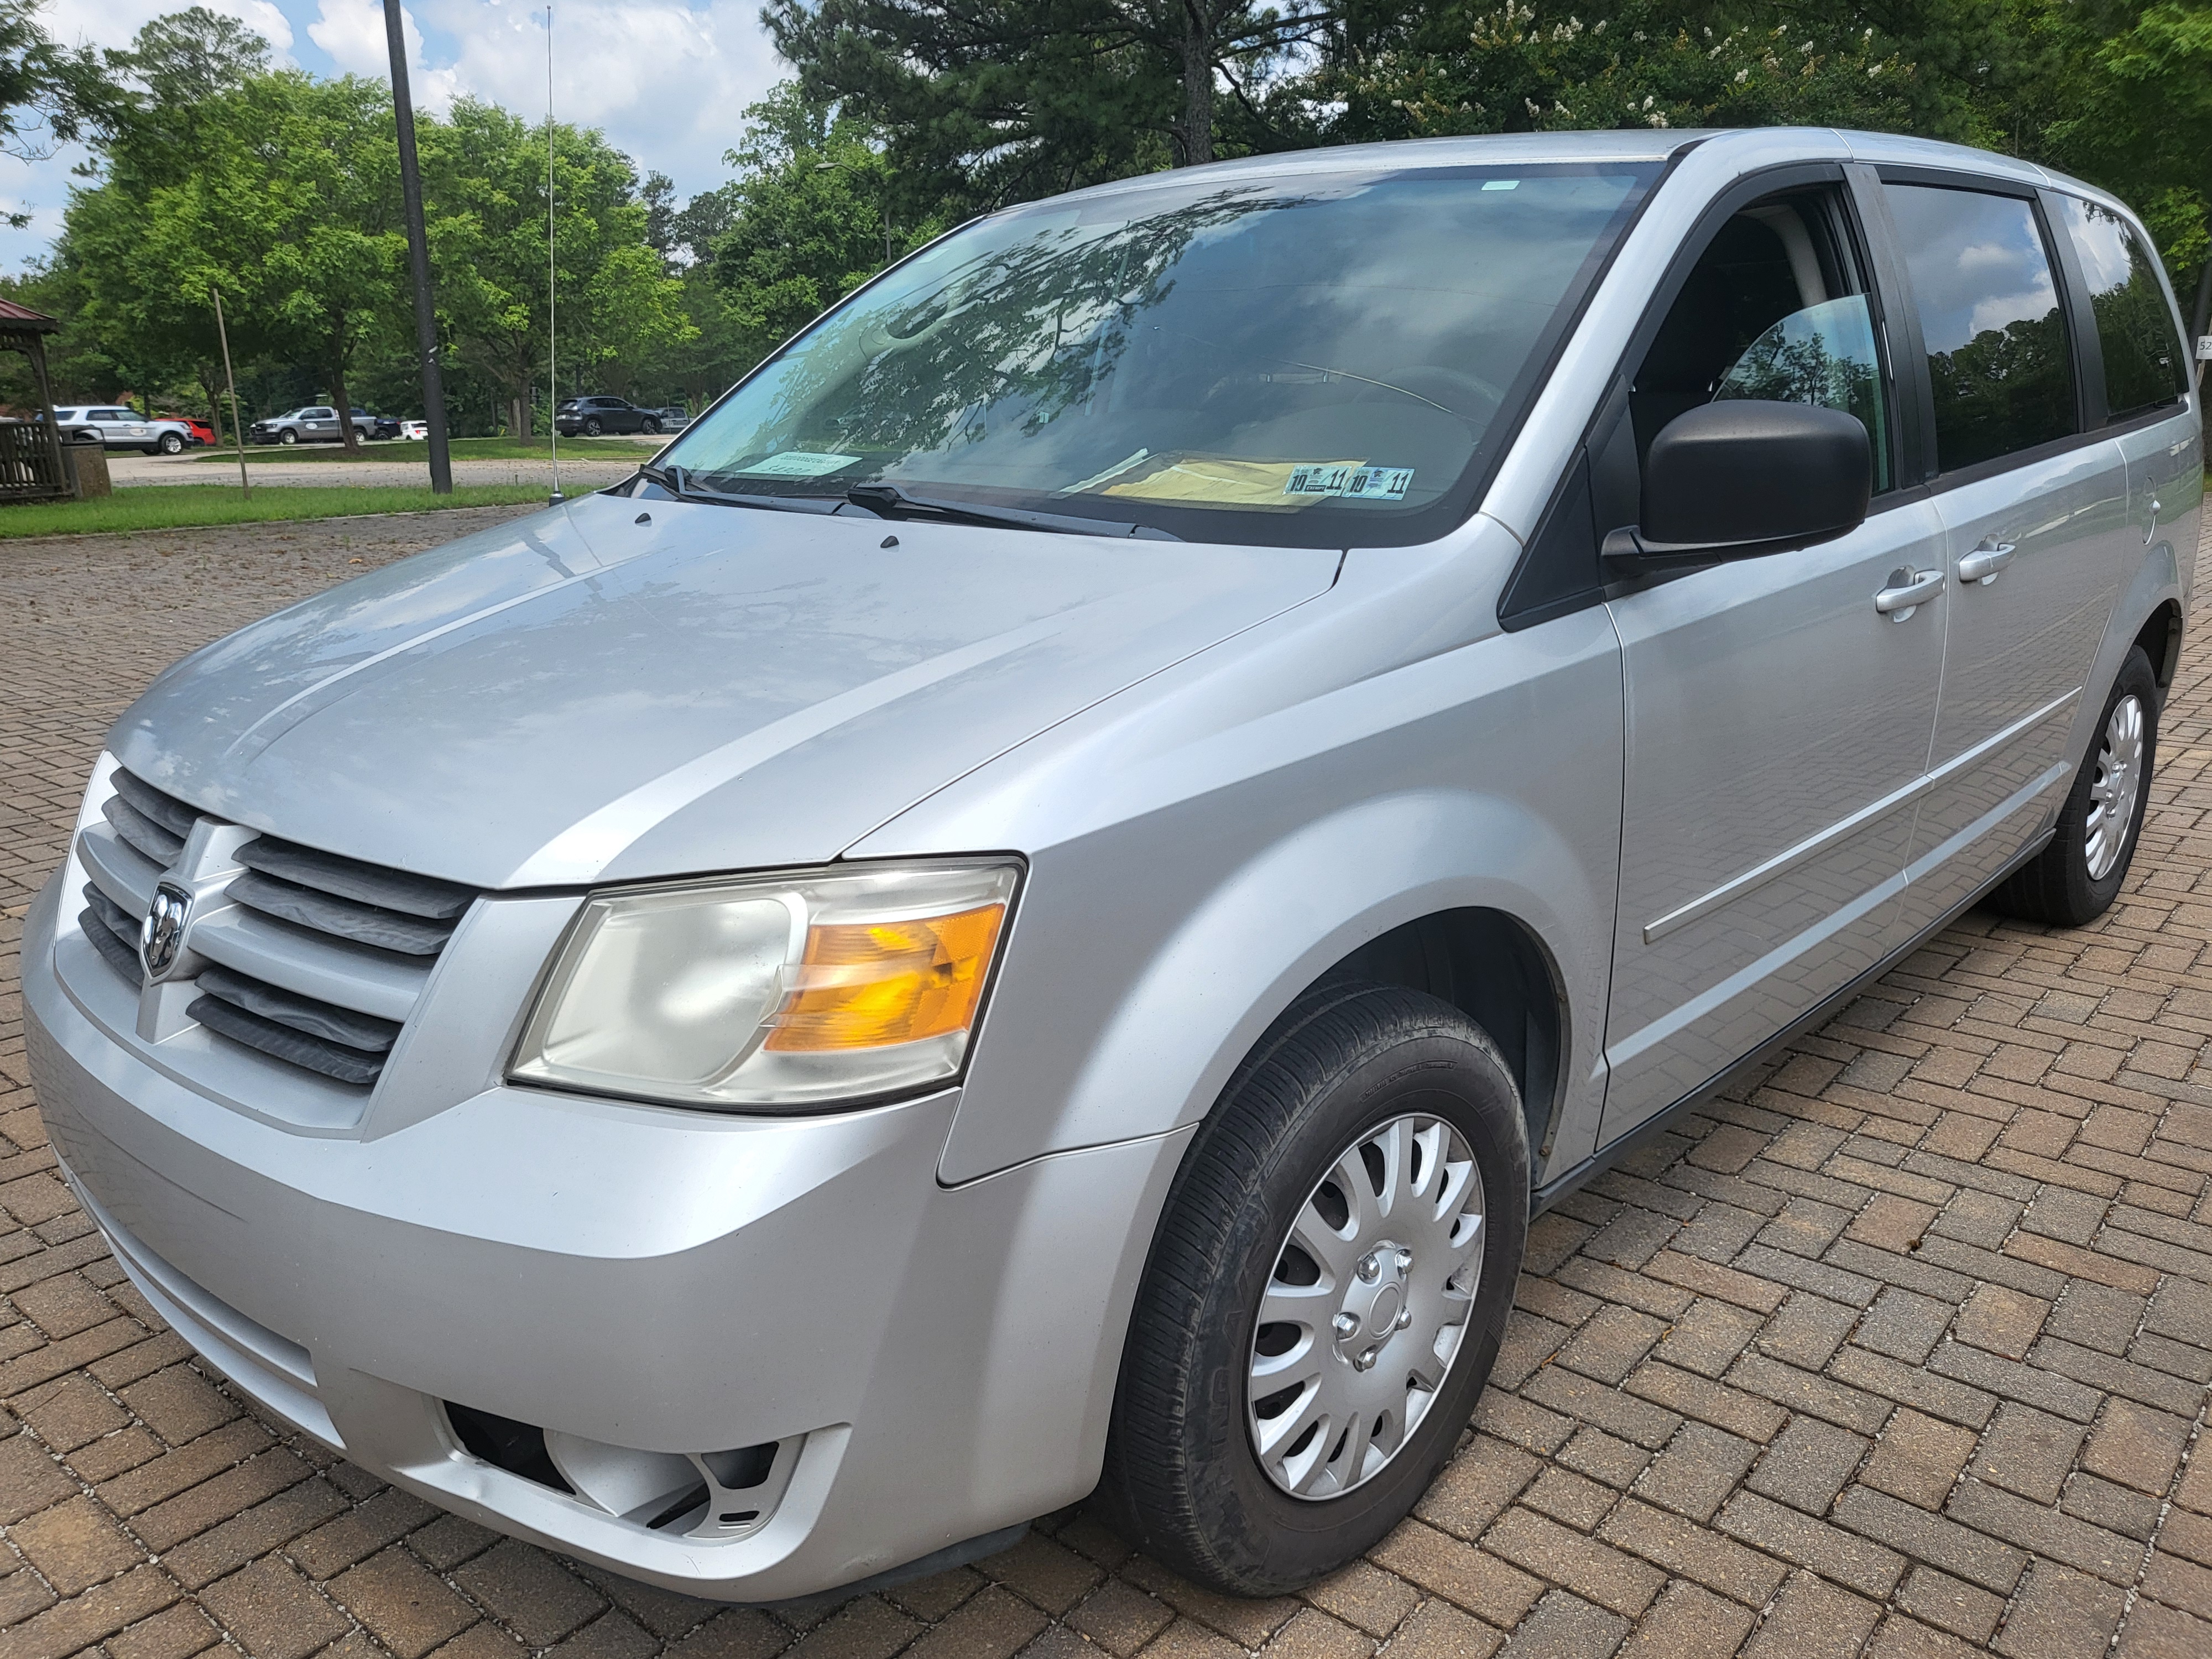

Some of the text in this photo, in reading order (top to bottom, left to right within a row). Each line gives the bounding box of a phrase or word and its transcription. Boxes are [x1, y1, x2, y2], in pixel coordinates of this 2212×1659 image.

[1290, 474, 1308, 492] 10
[1326, 468, 1349, 490] 11
[1349, 475, 1368, 493] 10
[1387, 473, 1409, 494] 11
